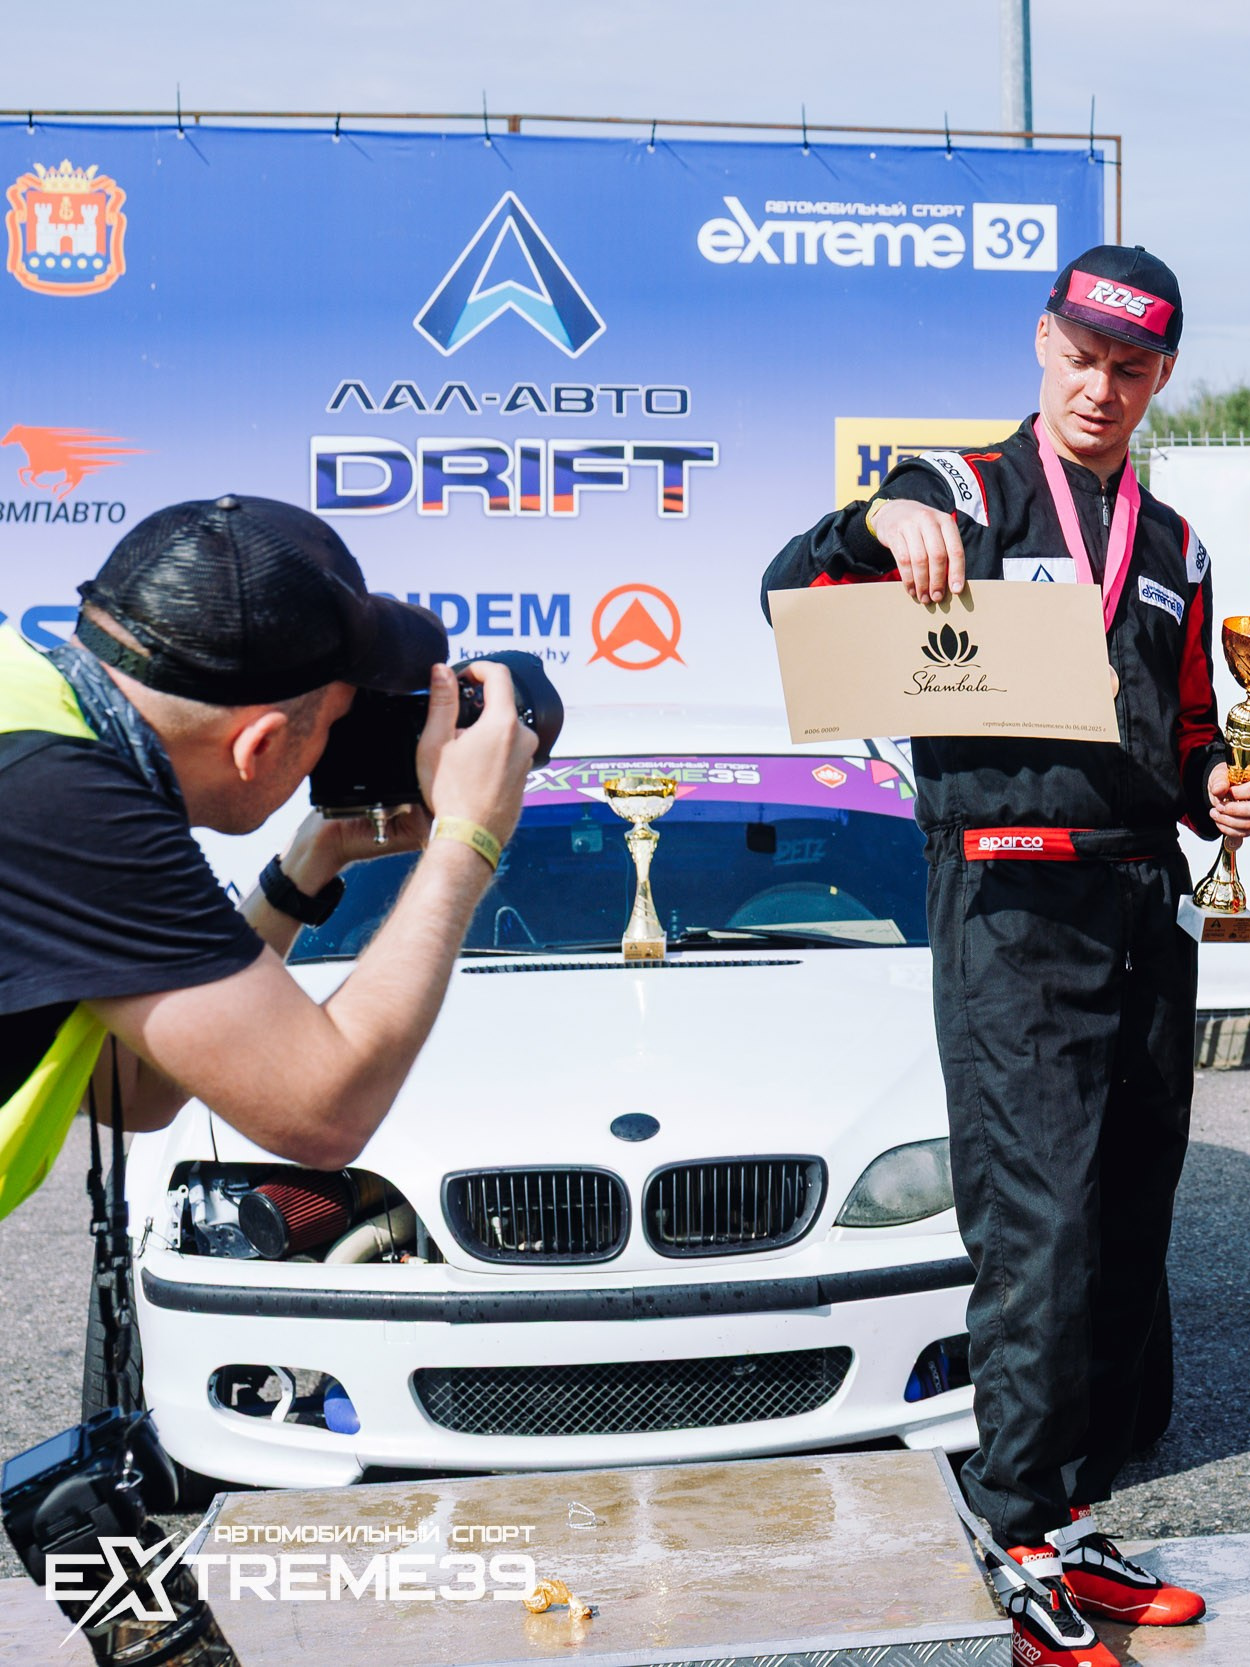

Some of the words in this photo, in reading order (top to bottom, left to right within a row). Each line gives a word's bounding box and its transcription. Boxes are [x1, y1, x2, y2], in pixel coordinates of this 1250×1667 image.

[765, 199, 906, 217] АВТОМОБИЛЬНЫЙ
[912, 203, 966, 218] СПОРТ
[985, 217, 1046, 260] 39
[1086, 280, 1154, 318] RDS
[310, 436, 720, 518] DRIFT
[0, 500, 127, 524] МПАВТО
[903, 670, 1008, 696] Shambala
[978, 835, 1044, 851] sparco
